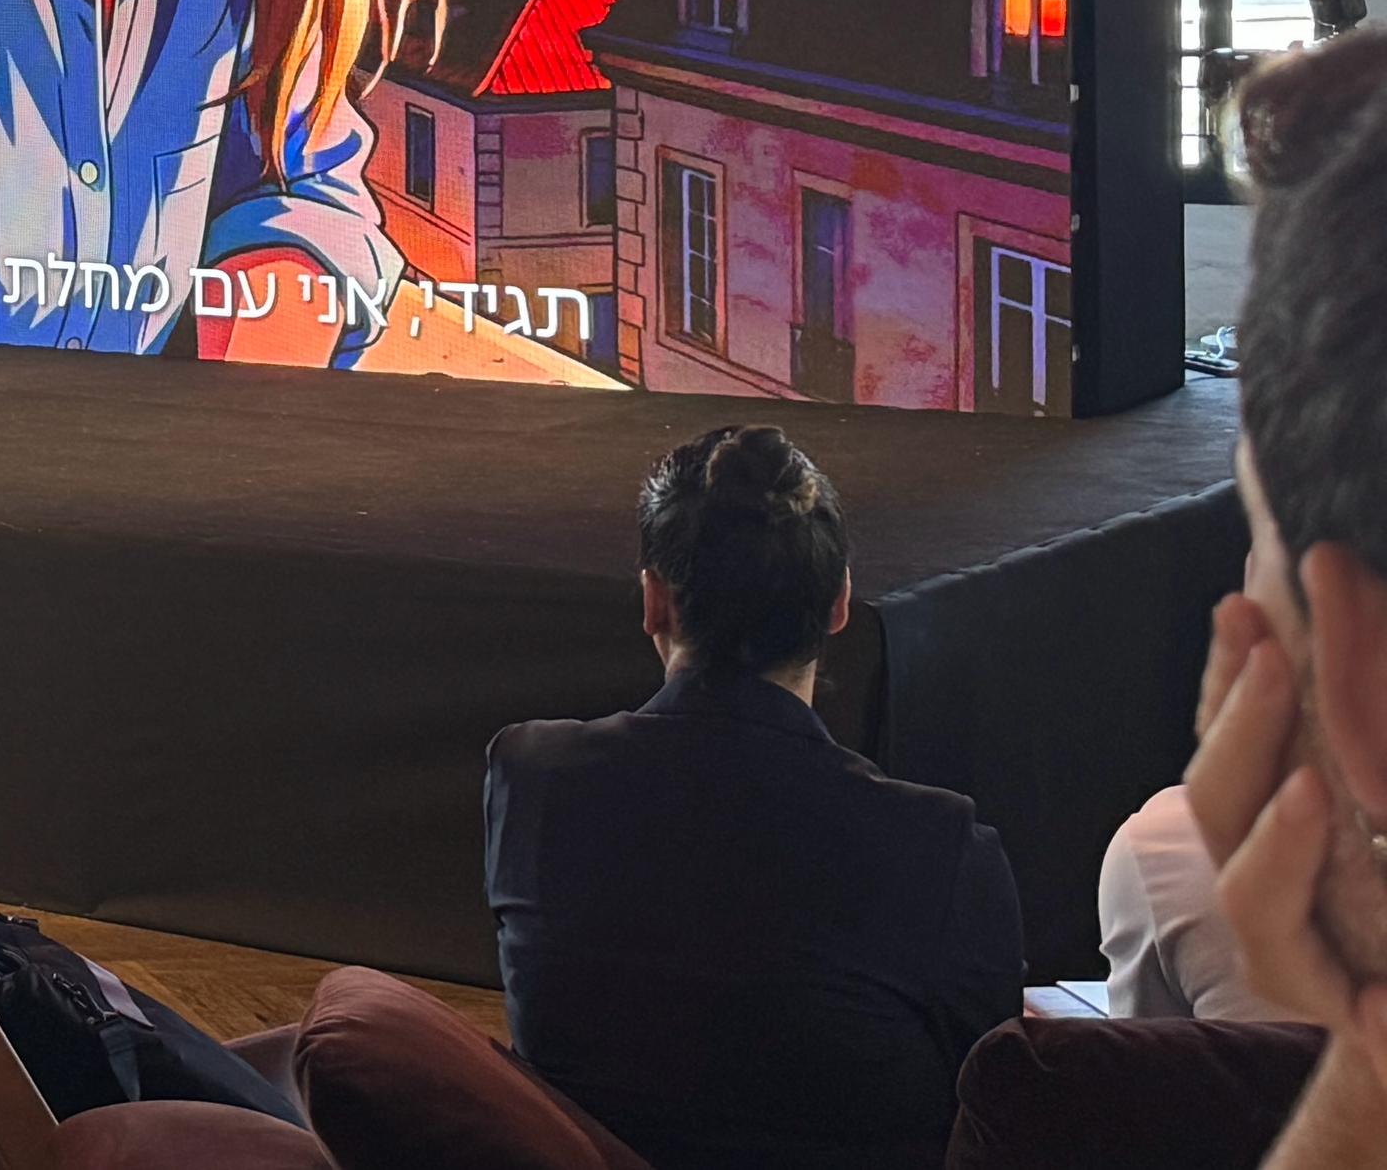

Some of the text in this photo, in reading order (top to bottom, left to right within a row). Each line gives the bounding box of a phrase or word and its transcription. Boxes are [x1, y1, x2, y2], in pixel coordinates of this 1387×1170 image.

[2, 251, 171, 313] מחלת
[188, 267, 276, 319] עם
[297, 273, 388, 328] אני
[409, 279, 591, 341] תגידי,
